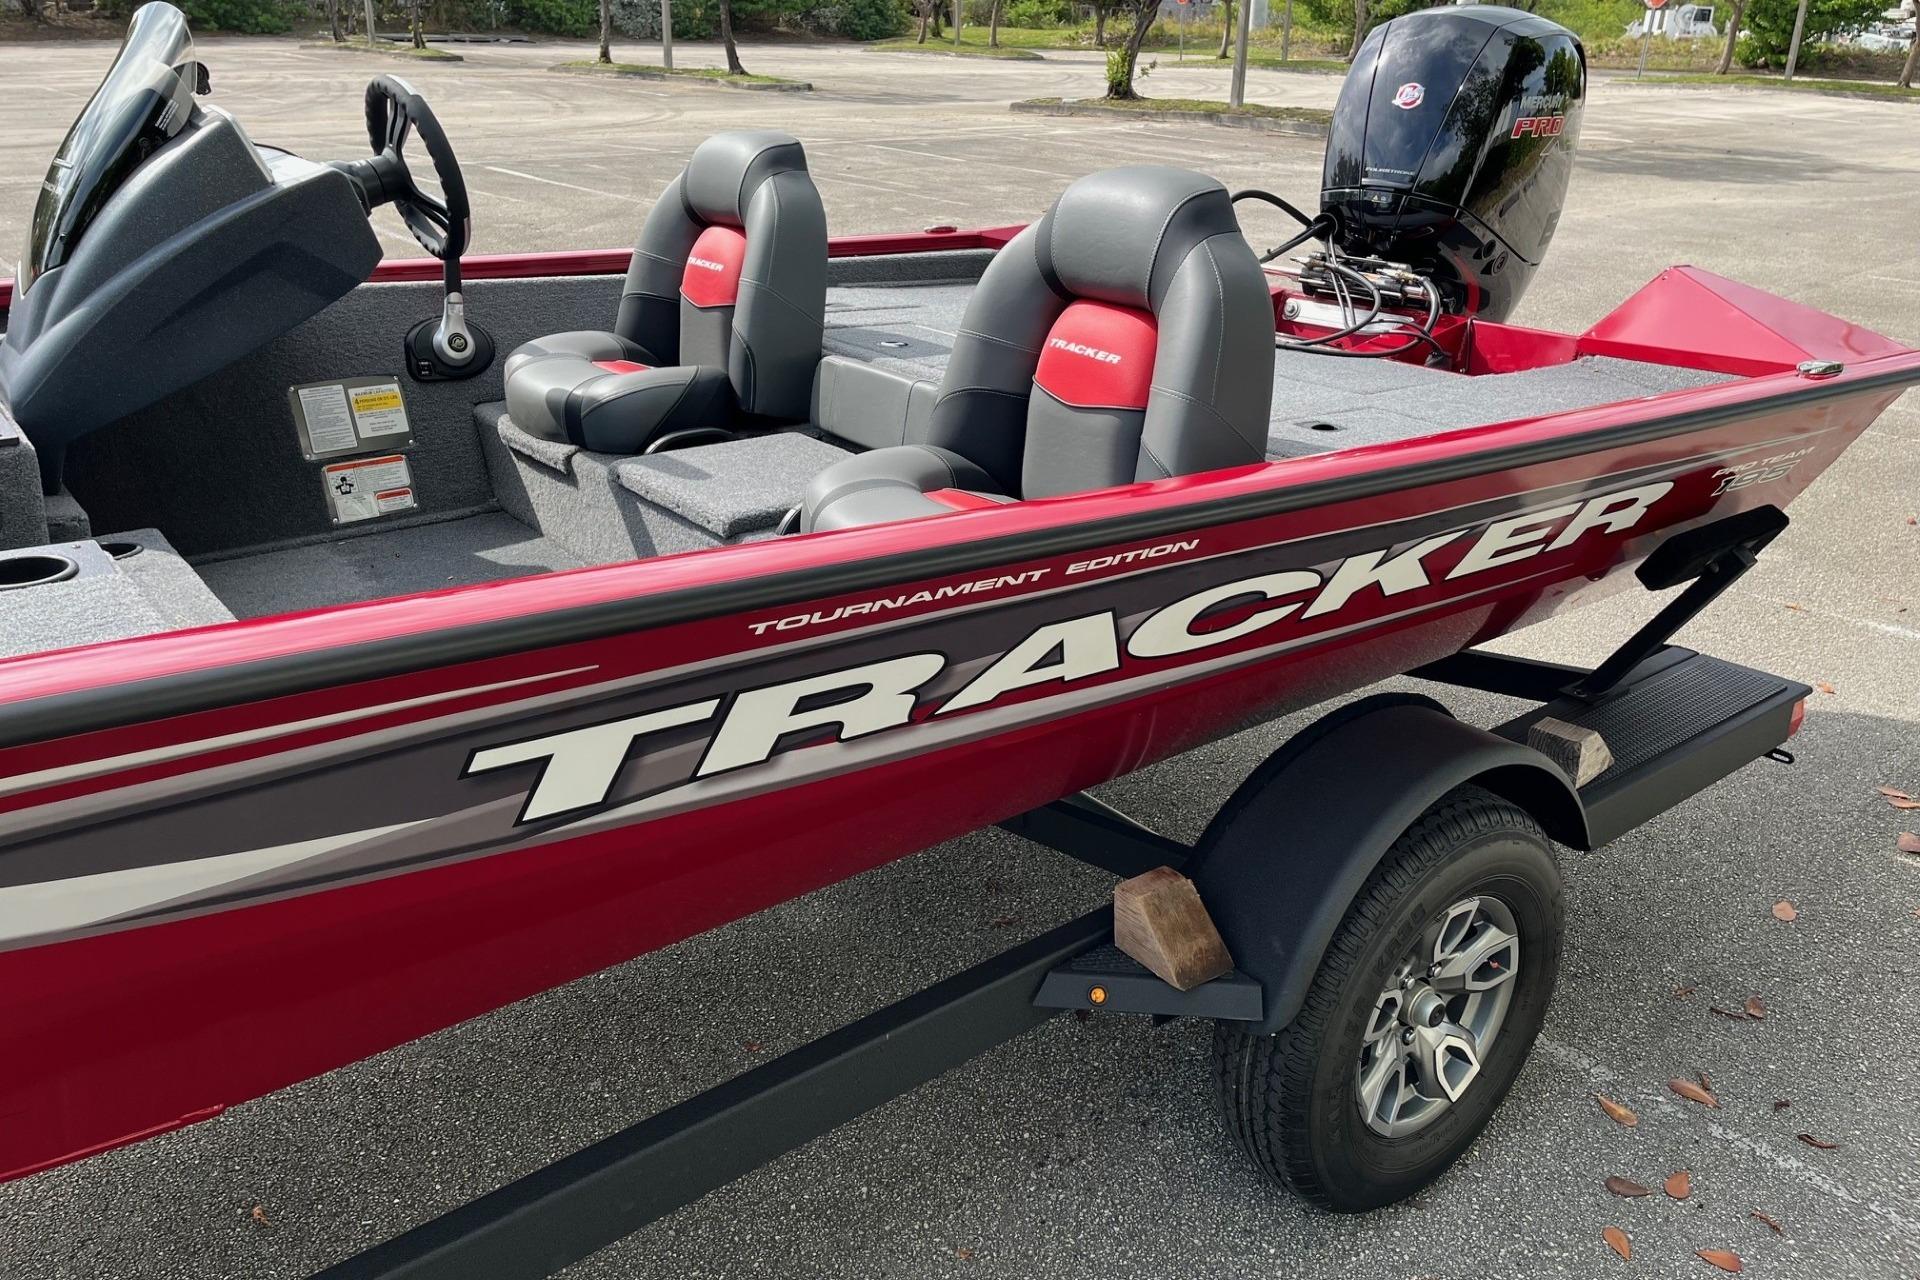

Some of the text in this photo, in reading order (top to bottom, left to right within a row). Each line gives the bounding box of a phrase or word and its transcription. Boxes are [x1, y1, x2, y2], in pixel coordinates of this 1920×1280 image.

[1510, 115, 1565, 139] PRO
[687, 256, 724, 272] TRACKER
[1049, 337, 1122, 364] TRACKER
[1711, 446, 1816, 479] PRO TEAM
[748, 538, 1200, 635] TOURNAMENT EDITION
[464, 480, 1675, 827] TRACKER
